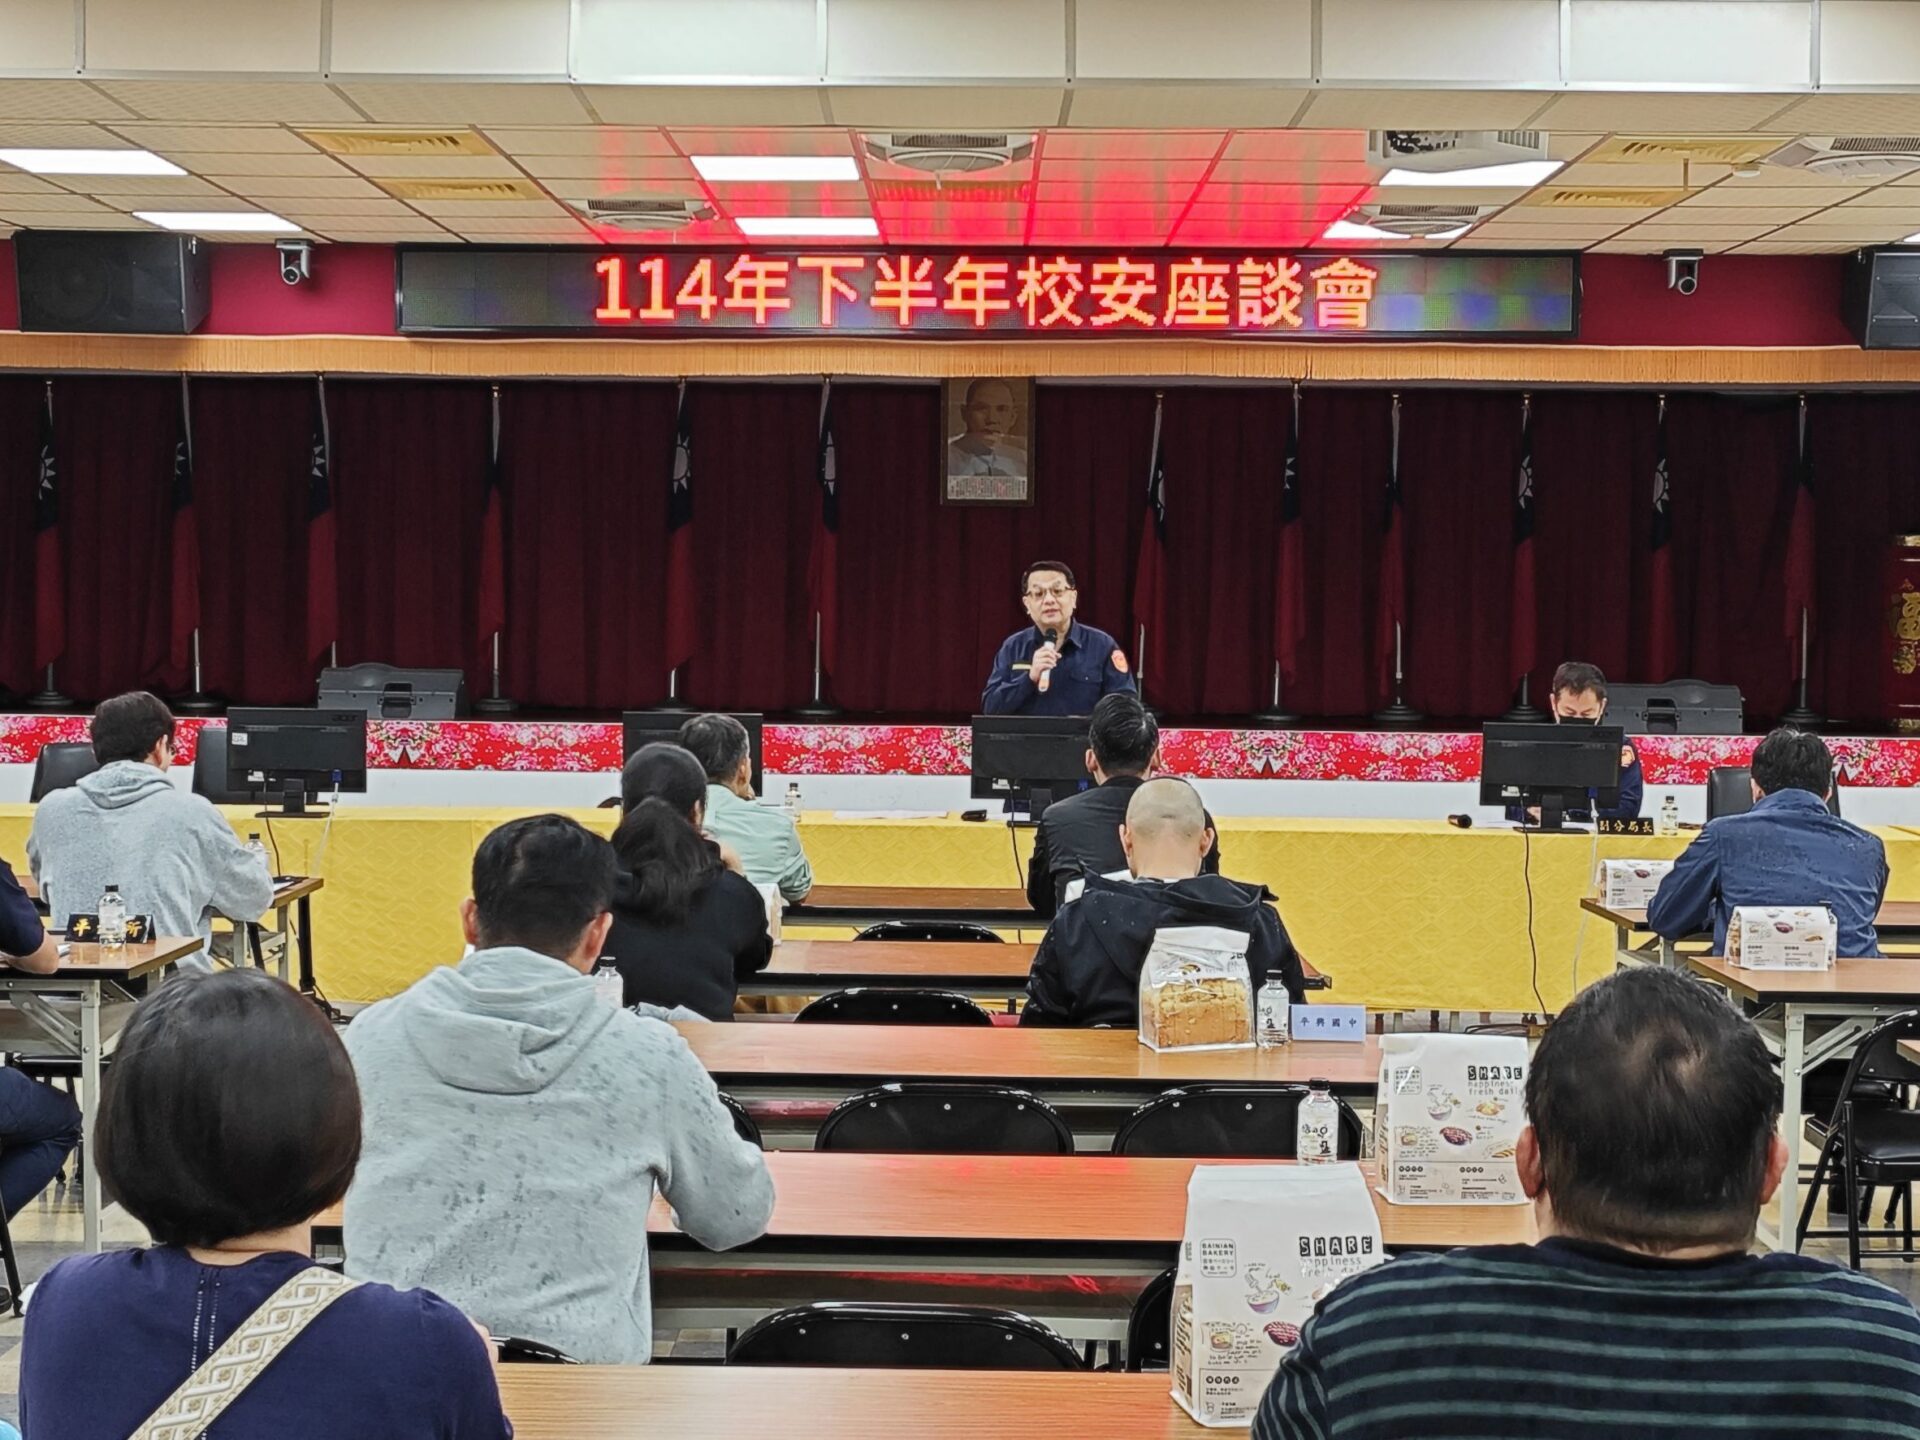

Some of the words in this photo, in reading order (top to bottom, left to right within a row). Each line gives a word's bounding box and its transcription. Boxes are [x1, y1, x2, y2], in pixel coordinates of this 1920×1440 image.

[595, 253, 1378, 328] 114年下半年校安座談會
[1599, 819, 1653, 832] 副分局長
[72, 917, 143, 938] 平所
[1467, 1065, 1523, 1081] SHARE
[1298, 1235, 1373, 1257] SHARE
